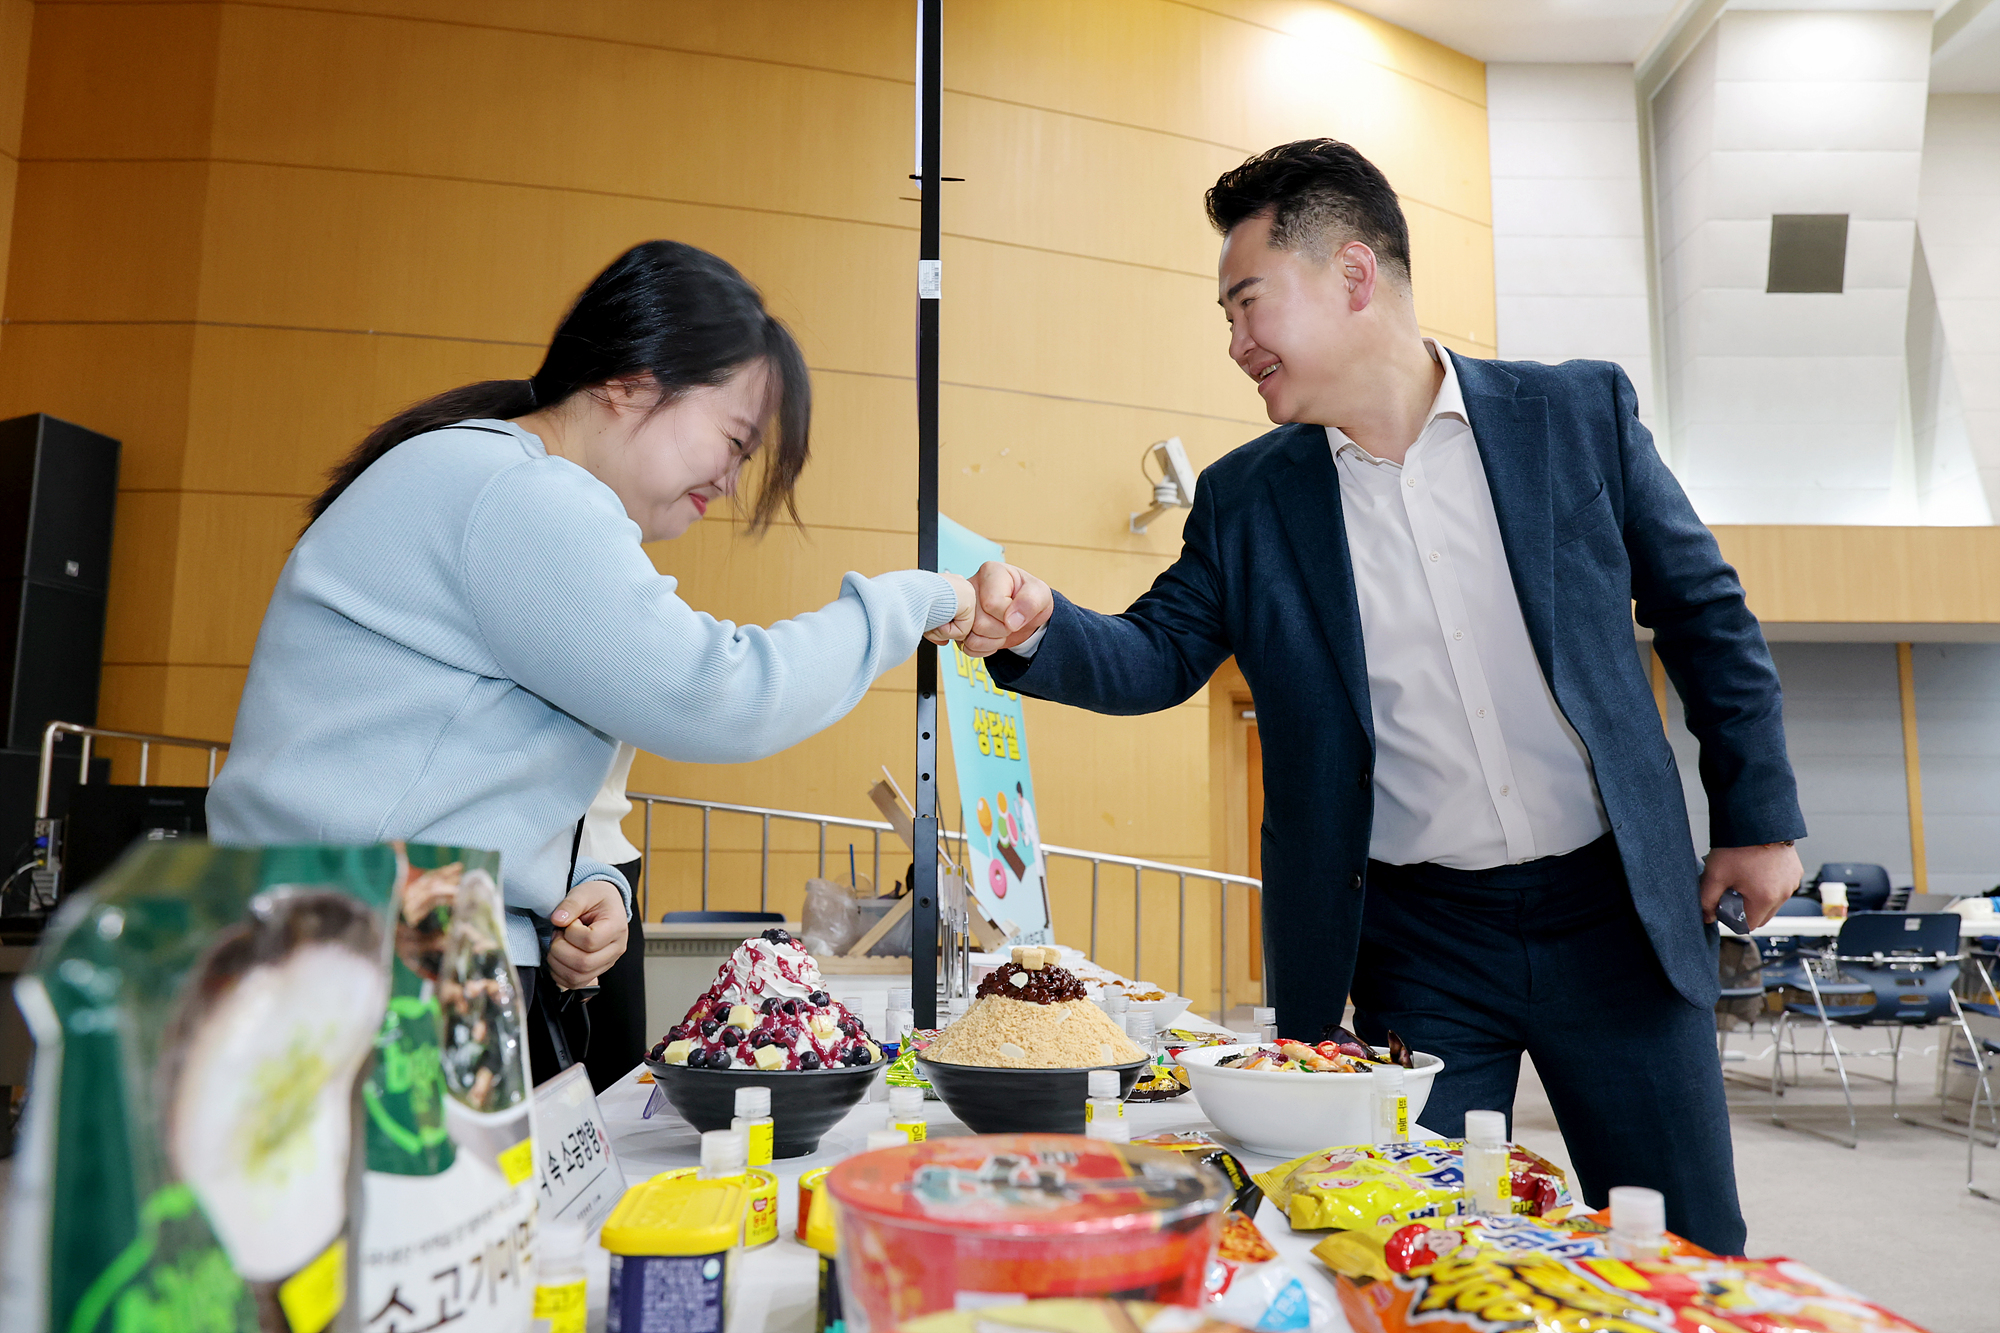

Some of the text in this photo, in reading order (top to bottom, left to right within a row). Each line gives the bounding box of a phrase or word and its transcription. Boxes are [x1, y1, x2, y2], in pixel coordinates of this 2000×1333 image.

[973, 706, 1021, 761] 상담실
[548, 1149, 565, 1187] 속
[560, 1117, 601, 1174] 소금함량
